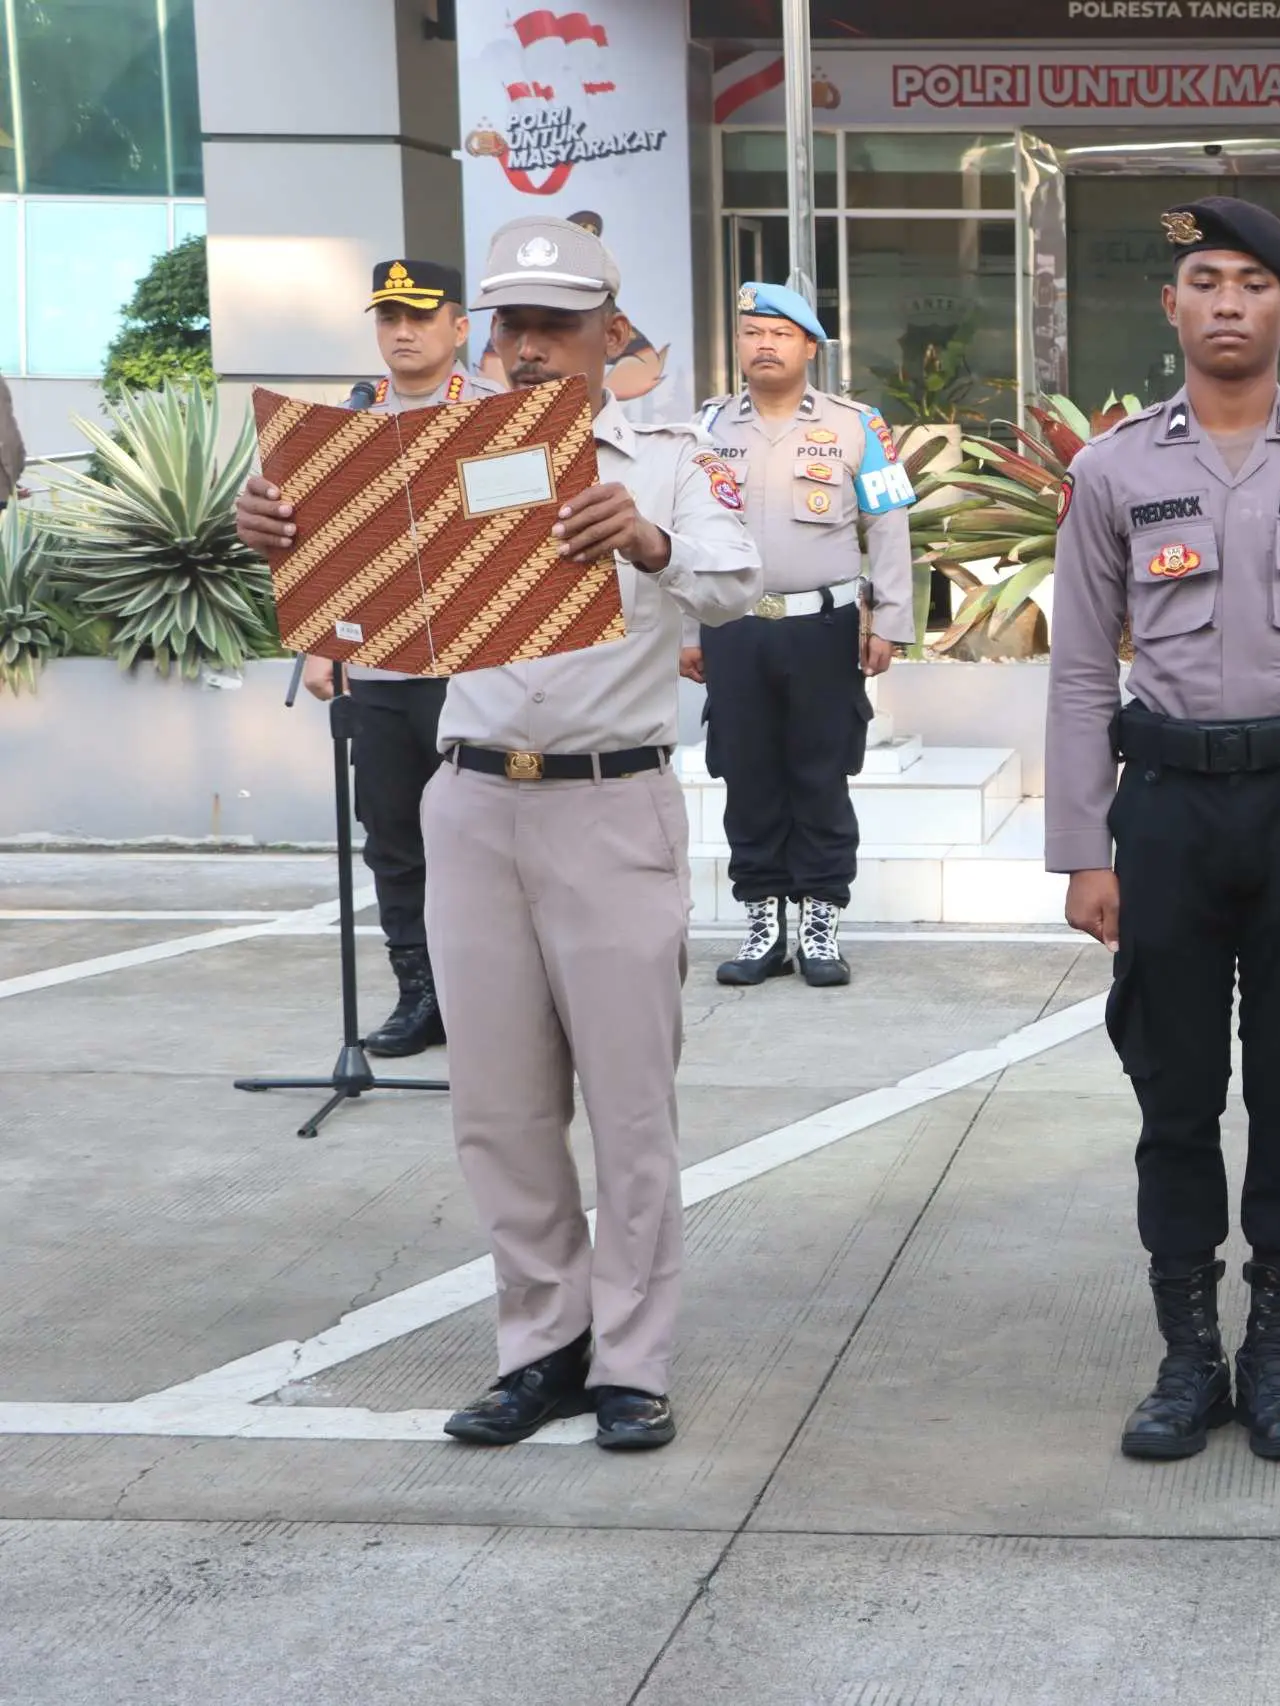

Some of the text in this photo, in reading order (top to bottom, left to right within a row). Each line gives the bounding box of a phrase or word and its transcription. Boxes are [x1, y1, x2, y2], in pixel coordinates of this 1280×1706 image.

[1068, 1, 1182, 18] POLRESTA
[893, 64, 1030, 108] POLRI
[1038, 64, 1210, 108] UNTUK
[506, 106, 572, 132] POLRI
[507, 121, 587, 150] UNTUK
[507, 129, 668, 171] MASYARAKAT
[797, 446, 843, 459] POLRI
[861, 463, 916, 510] PM
[1131, 495, 1203, 528] FREDERICK
